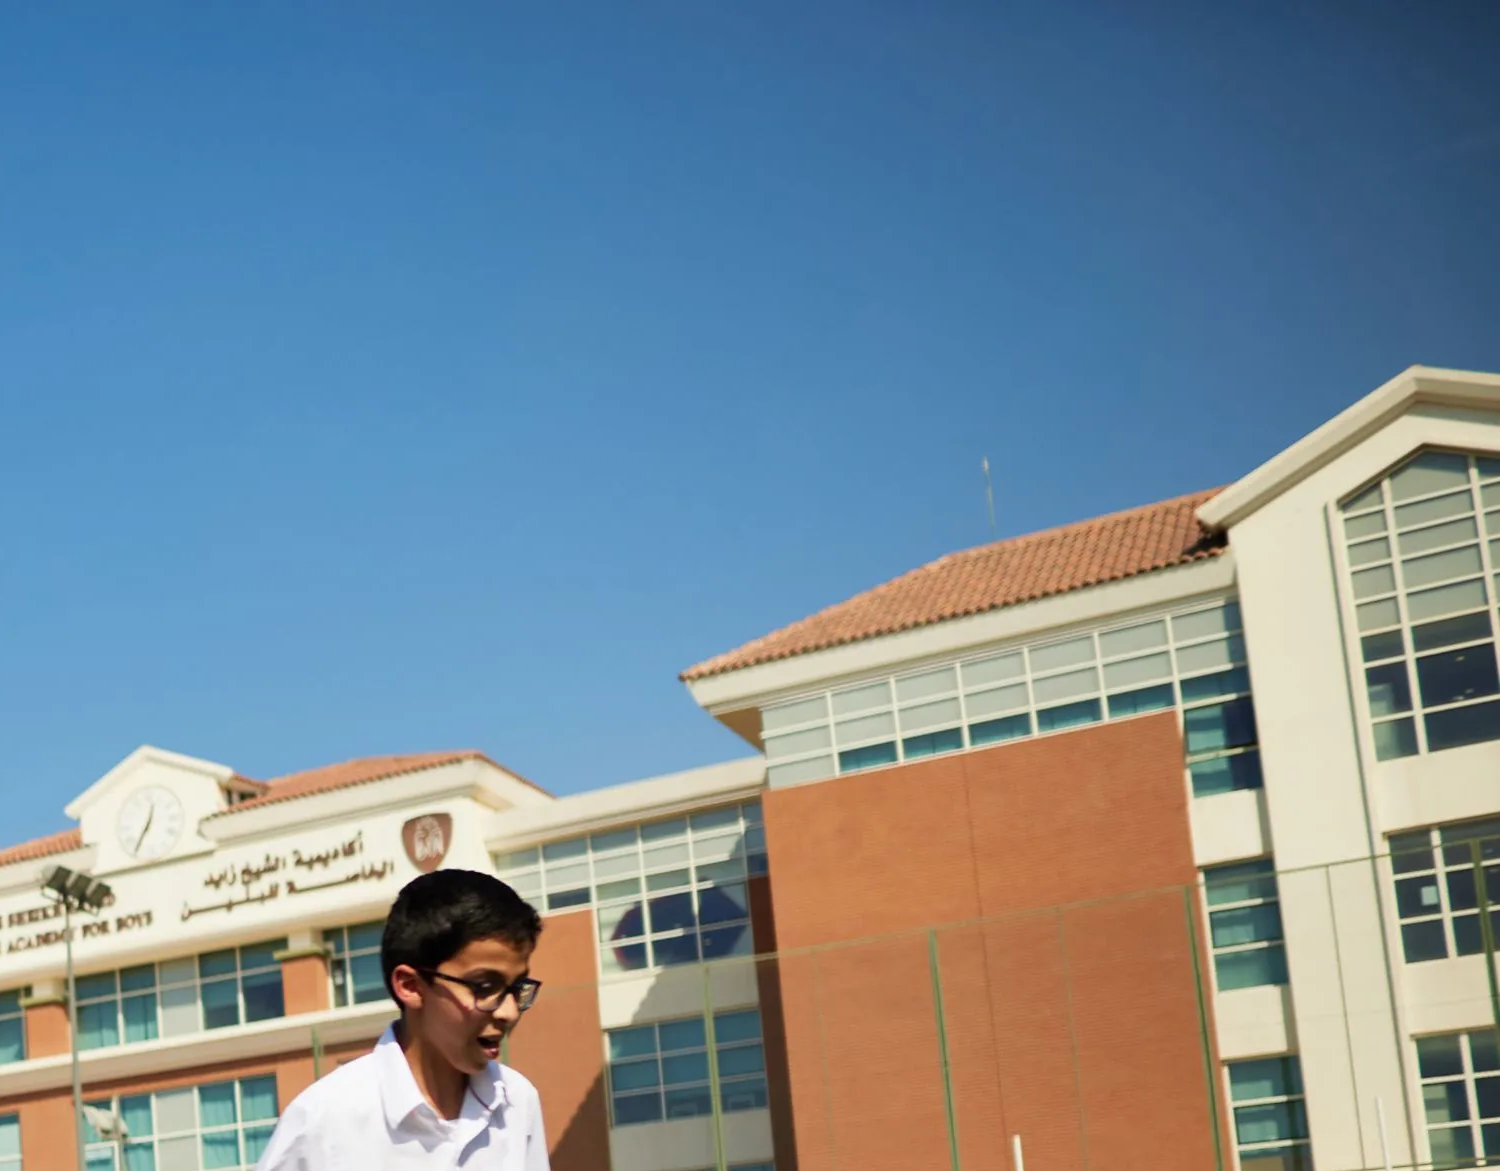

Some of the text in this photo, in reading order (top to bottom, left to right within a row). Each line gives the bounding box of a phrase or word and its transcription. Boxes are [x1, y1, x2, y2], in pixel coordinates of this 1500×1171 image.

[293, 830, 364, 871] أكاديمية
[240, 853, 286, 885] الشيخ
[82, 920, 109, 938] FOR
[116, 910, 152, 932] BOYS
